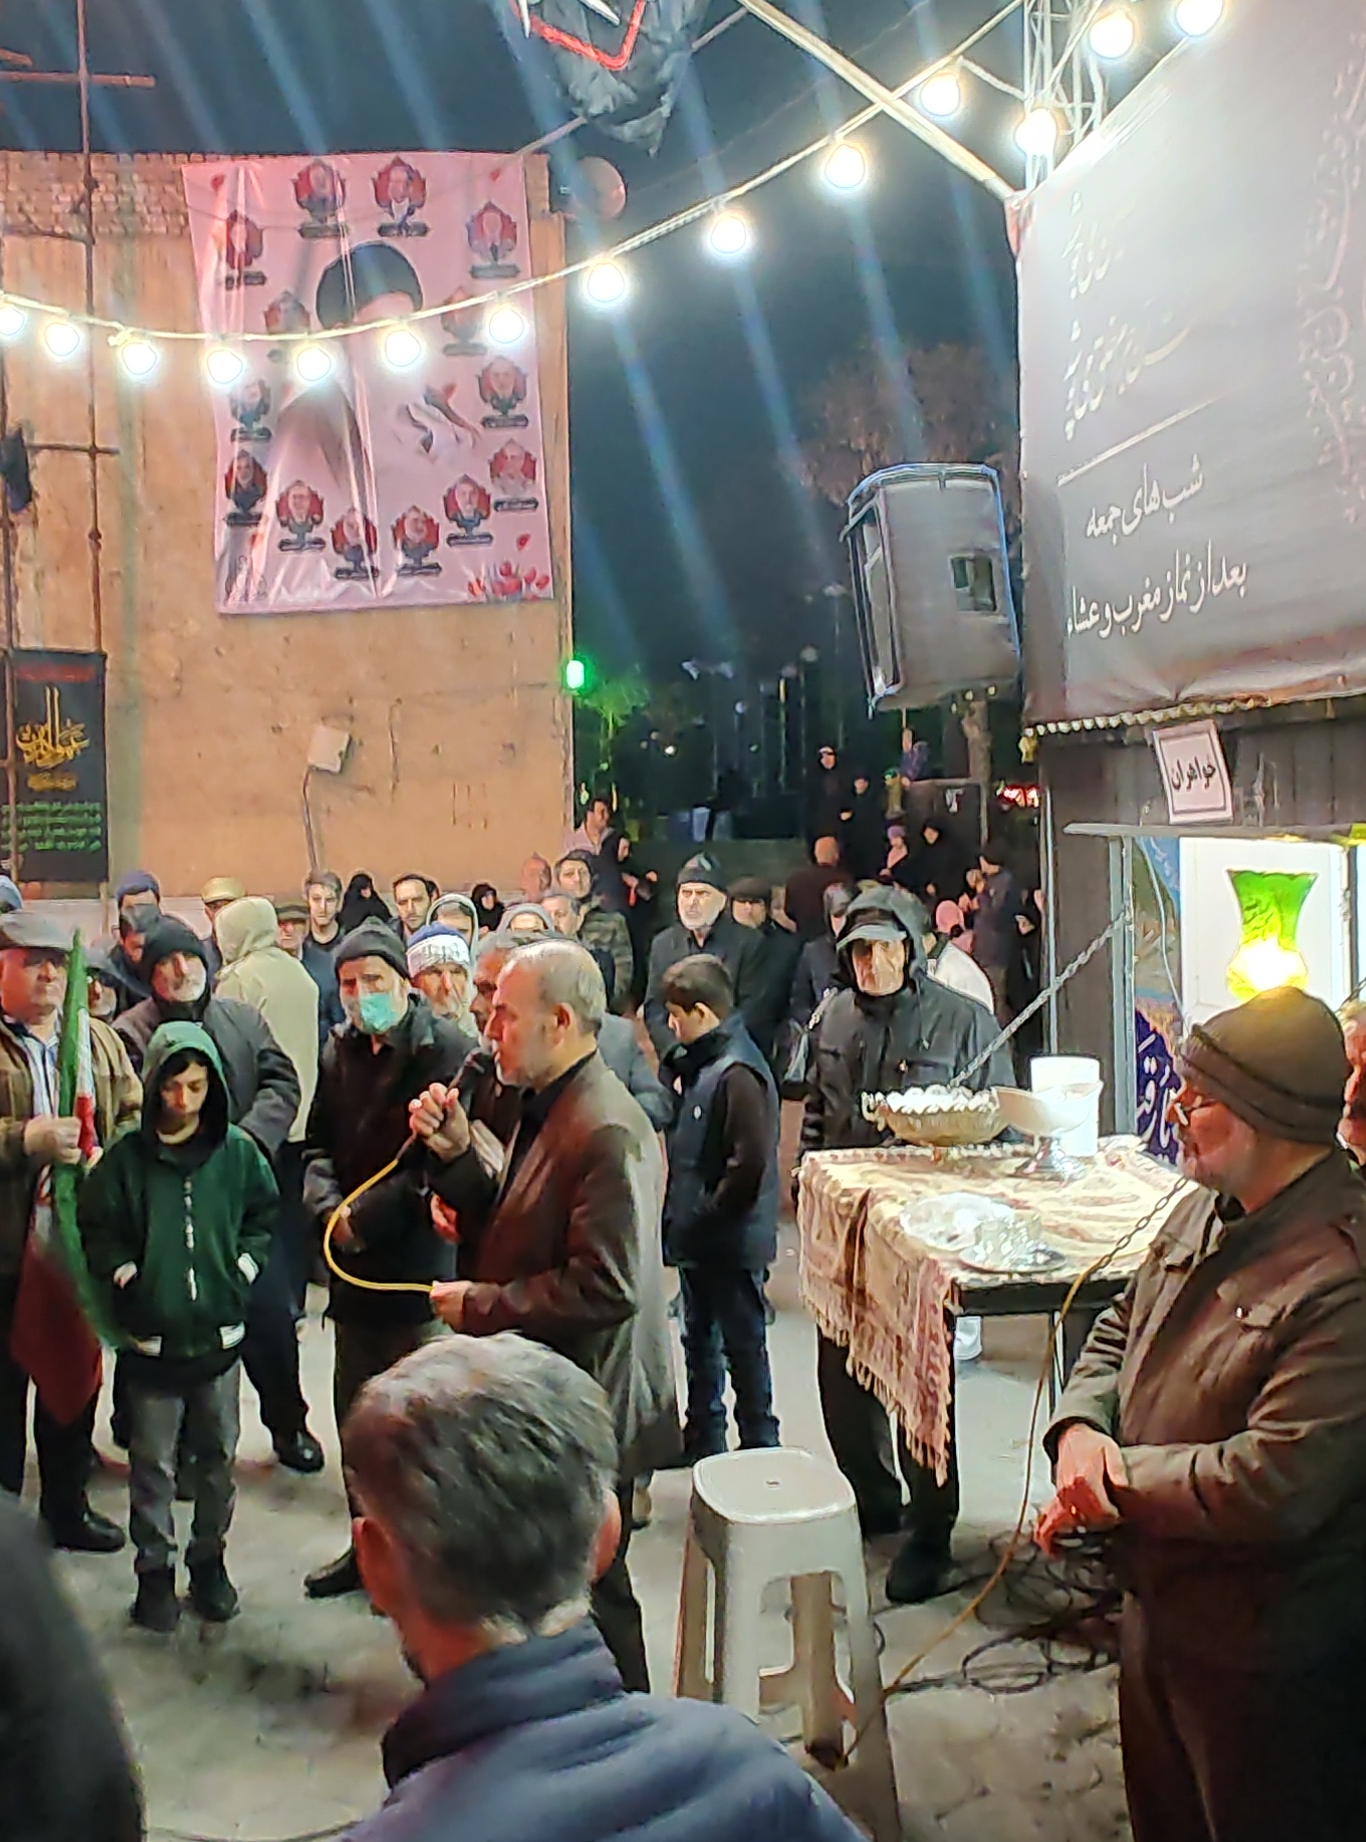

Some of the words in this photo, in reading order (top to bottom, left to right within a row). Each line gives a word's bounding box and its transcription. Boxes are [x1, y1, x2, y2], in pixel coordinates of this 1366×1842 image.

[1121, 462, 1161, 535] های
[1162, 453, 1203, 524] شب
[1086, 505, 1122, 545] جمعه
[1158, 549, 1191, 622] نماز
[1189, 538, 1212, 613] از
[1211, 555, 1248, 598] بعد
[1098, 602, 1112, 638] و
[1113, 577, 1161, 636] مغرب
[1171, 754, 1217, 791] خواهران
